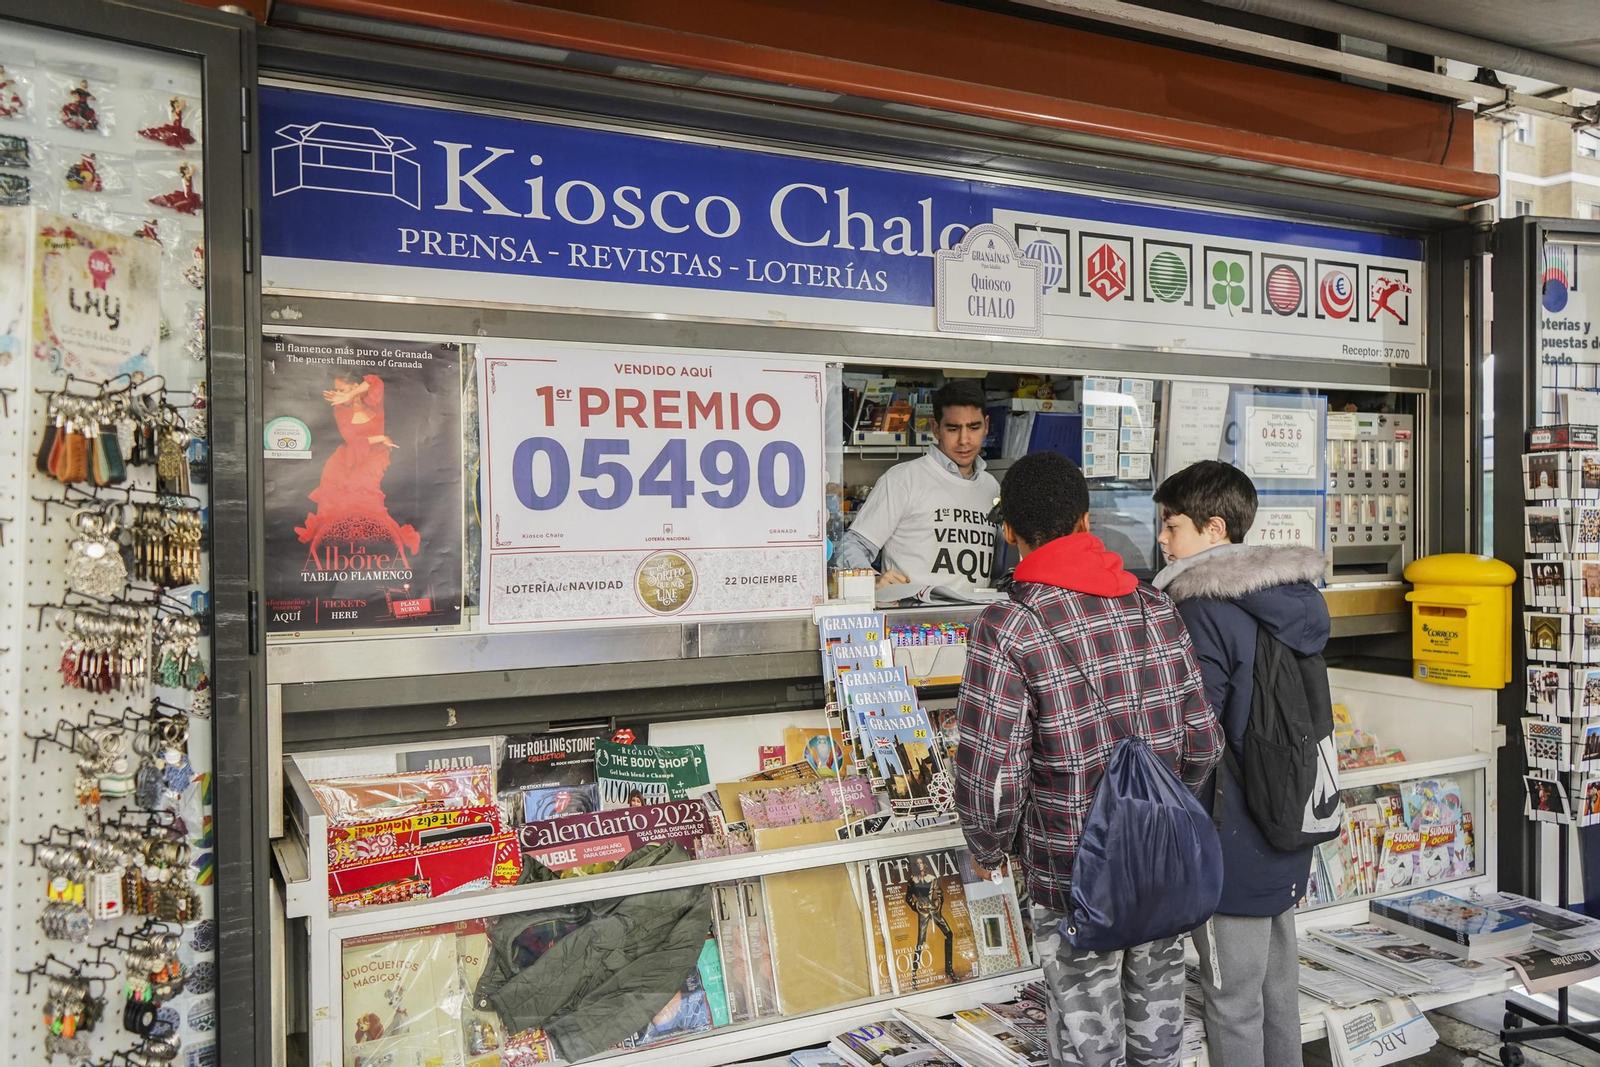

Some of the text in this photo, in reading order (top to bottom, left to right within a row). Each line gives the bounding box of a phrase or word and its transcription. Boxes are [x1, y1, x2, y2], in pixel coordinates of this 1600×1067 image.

[433, 139, 741, 238] Kiosco
[398, 228, 888, 293] PRENSA REVISTAS LOTERÍAS
[972, 250, 1010, 264] GRANAÍNAS
[971, 273, 1011, 292] Quiosco
[968, 294, 1015, 319] CHALO
[1542, 318, 1591, 334] oterías y
[1542, 336, 1588, 350] puestas
[275, 343, 433, 359] El flamenco más puro de Granada
[1342, 344, 1410, 360] Receptor: 37.070
[287, 354, 423, 369] The purest flamenco of Granada
[1542, 352, 1572, 366] stado
[614, 363, 713, 379] VENDIDO AQUÍ
[1192, 388, 1209, 398] BOTES
[579, 387, 781, 432] PREMIO
[1262, 428, 1302, 440] 04536
[512, 436, 806, 511] 05490
[954, 509, 996, 528] PREM
[934, 528, 994, 547] VENDID
[1261, 529, 1301, 540] 76118
[350, 543, 366, 554] La
[931, 548, 992, 583] AQU
[301, 570, 413, 582] TABLAO FLAMENCO
[725, 575, 798, 586] 22 DICIEMBRE
[323, 600, 367, 608] TICKETS
[273, 610, 301, 623] AQUÍ
[331, 611, 358, 620] HERE
[825, 616, 880, 631] GRANADA
[1428, 629, 1458, 638] CORREOS
[835, 645, 886, 659] GRANADA
[846, 670, 901, 687] GRANADA
[855, 689, 911, 705] GRANADA
[869, 713, 925, 731] GRANADA
[508, 744, 526, 759] THE
[527, 737, 566, 756] ROLLING
[528, 752, 566, 762] COLLECTION
[611, 755, 628, 766] THE
[631, 758, 656, 768] BODY
[659, 757, 688, 769] SHOP
[830, 784, 862, 796] REGALO
[834, 791, 865, 804] AGENDA
[520, 802, 705, 849] Calendario 2023
[1430, 825, 1454, 836] SUDOKU
[1394, 832, 1420, 842] SUDOKU
[536, 848, 578, 866] MUEBLE
[599, 848, 626, 857] DECORAR
[896, 950, 933, 973] ORO
[1551, 953, 1591, 966] CincoDías
[343, 960, 419, 981] UDIOCUENTOS
[353, 972, 402, 989] MÁGICOS
[850, 1024, 884, 1048] AD
[1370, 1028, 1407, 1057] ABC
